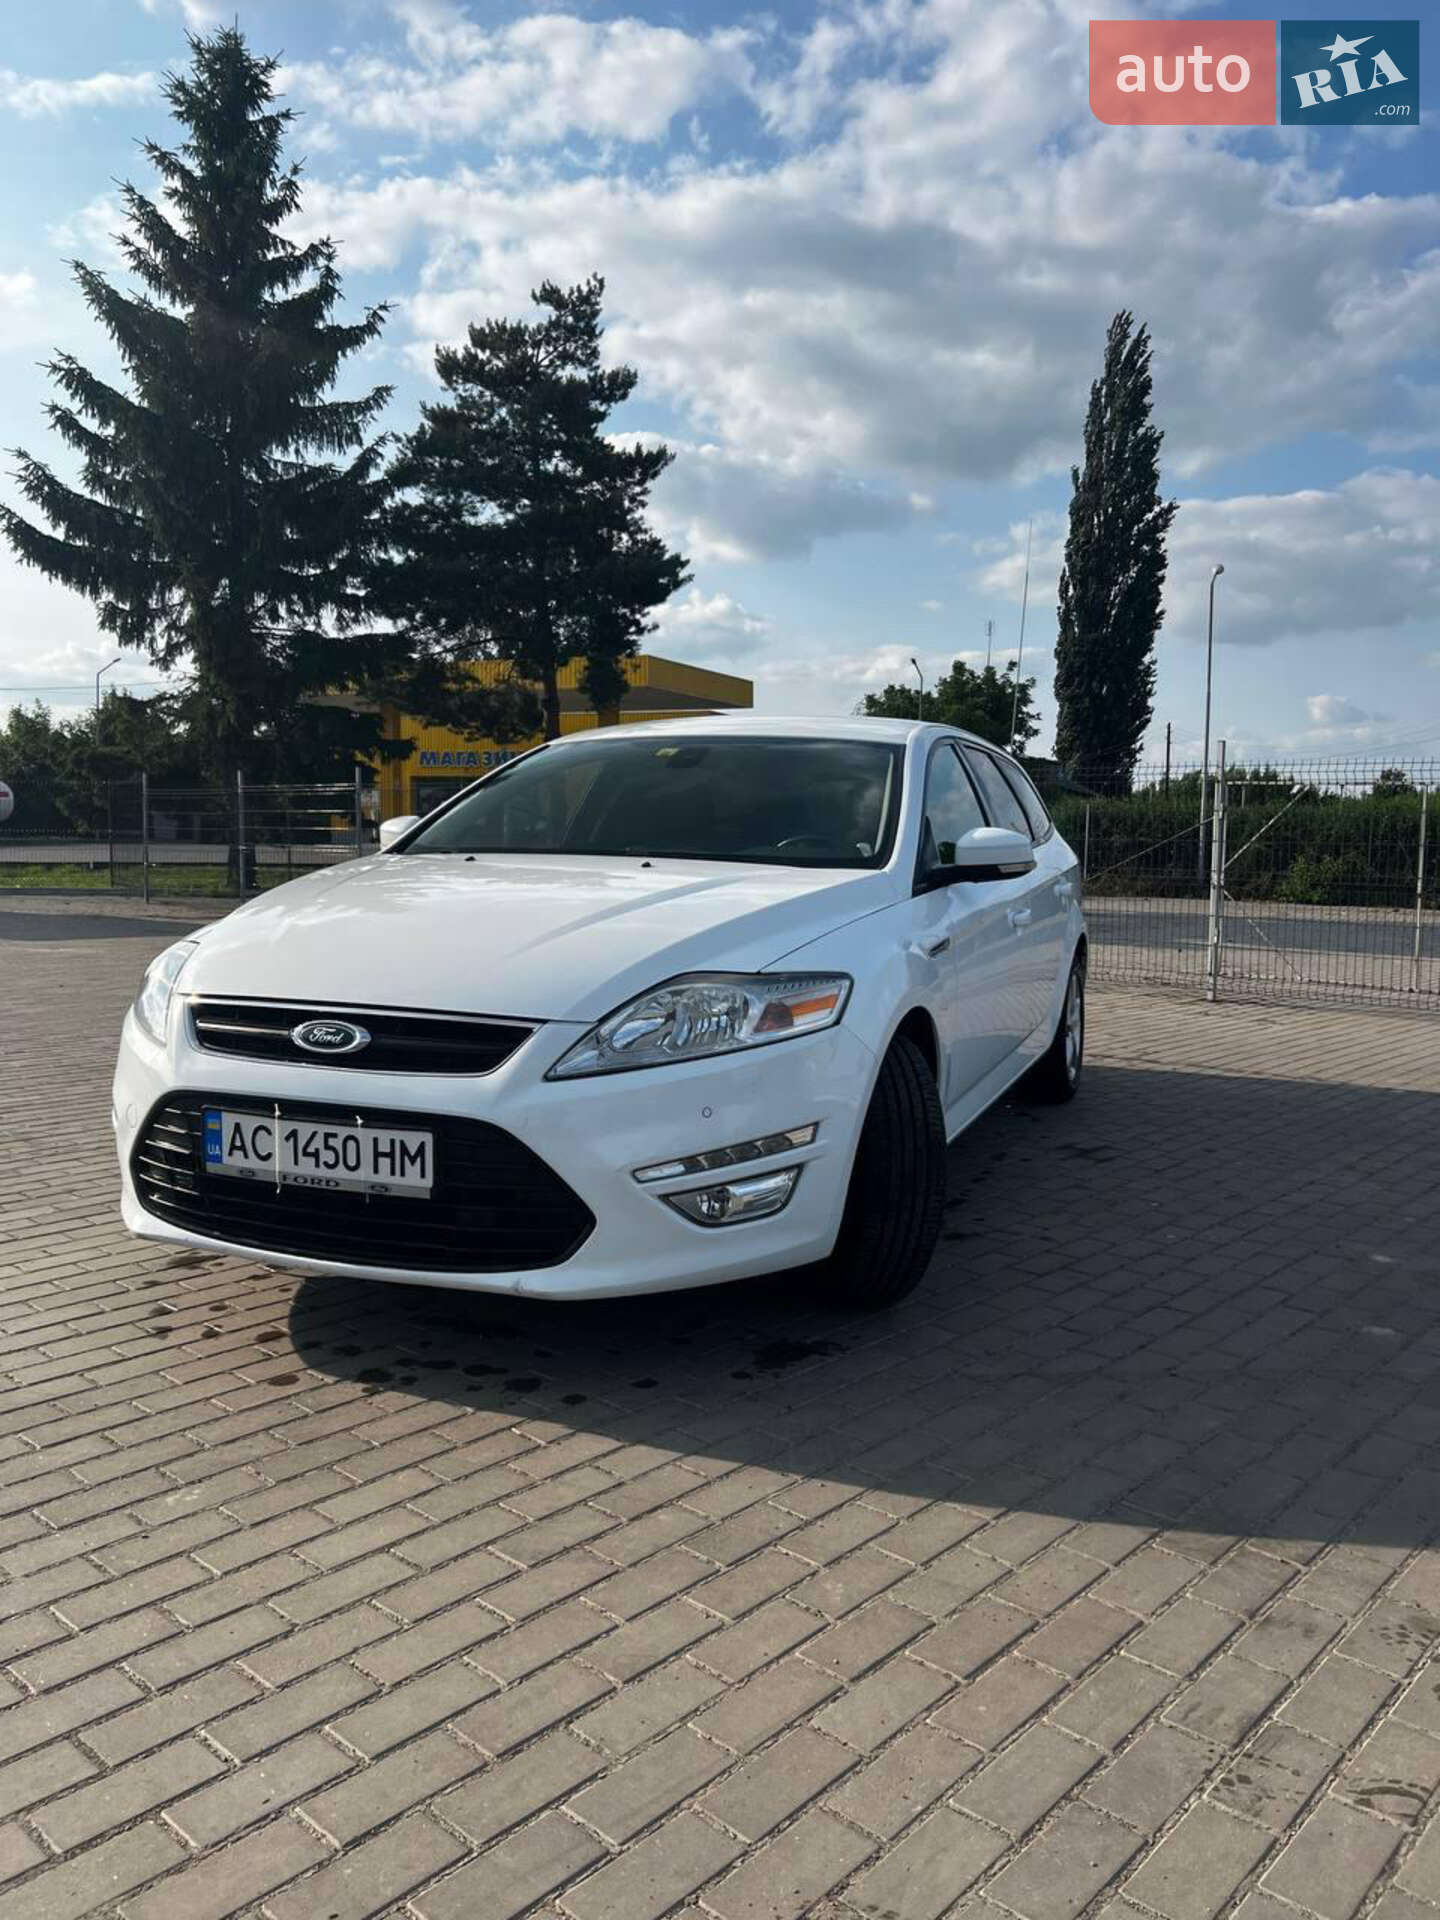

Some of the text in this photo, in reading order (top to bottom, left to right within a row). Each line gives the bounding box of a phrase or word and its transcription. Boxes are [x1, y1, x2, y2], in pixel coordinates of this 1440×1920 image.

[420, 751, 519, 768] МАГАЗИ
[309, 1026, 345, 1044] Ford
[207, 1121, 427, 1179] UA AC 1450 HM
[282, 1174, 340, 1188] FORD
